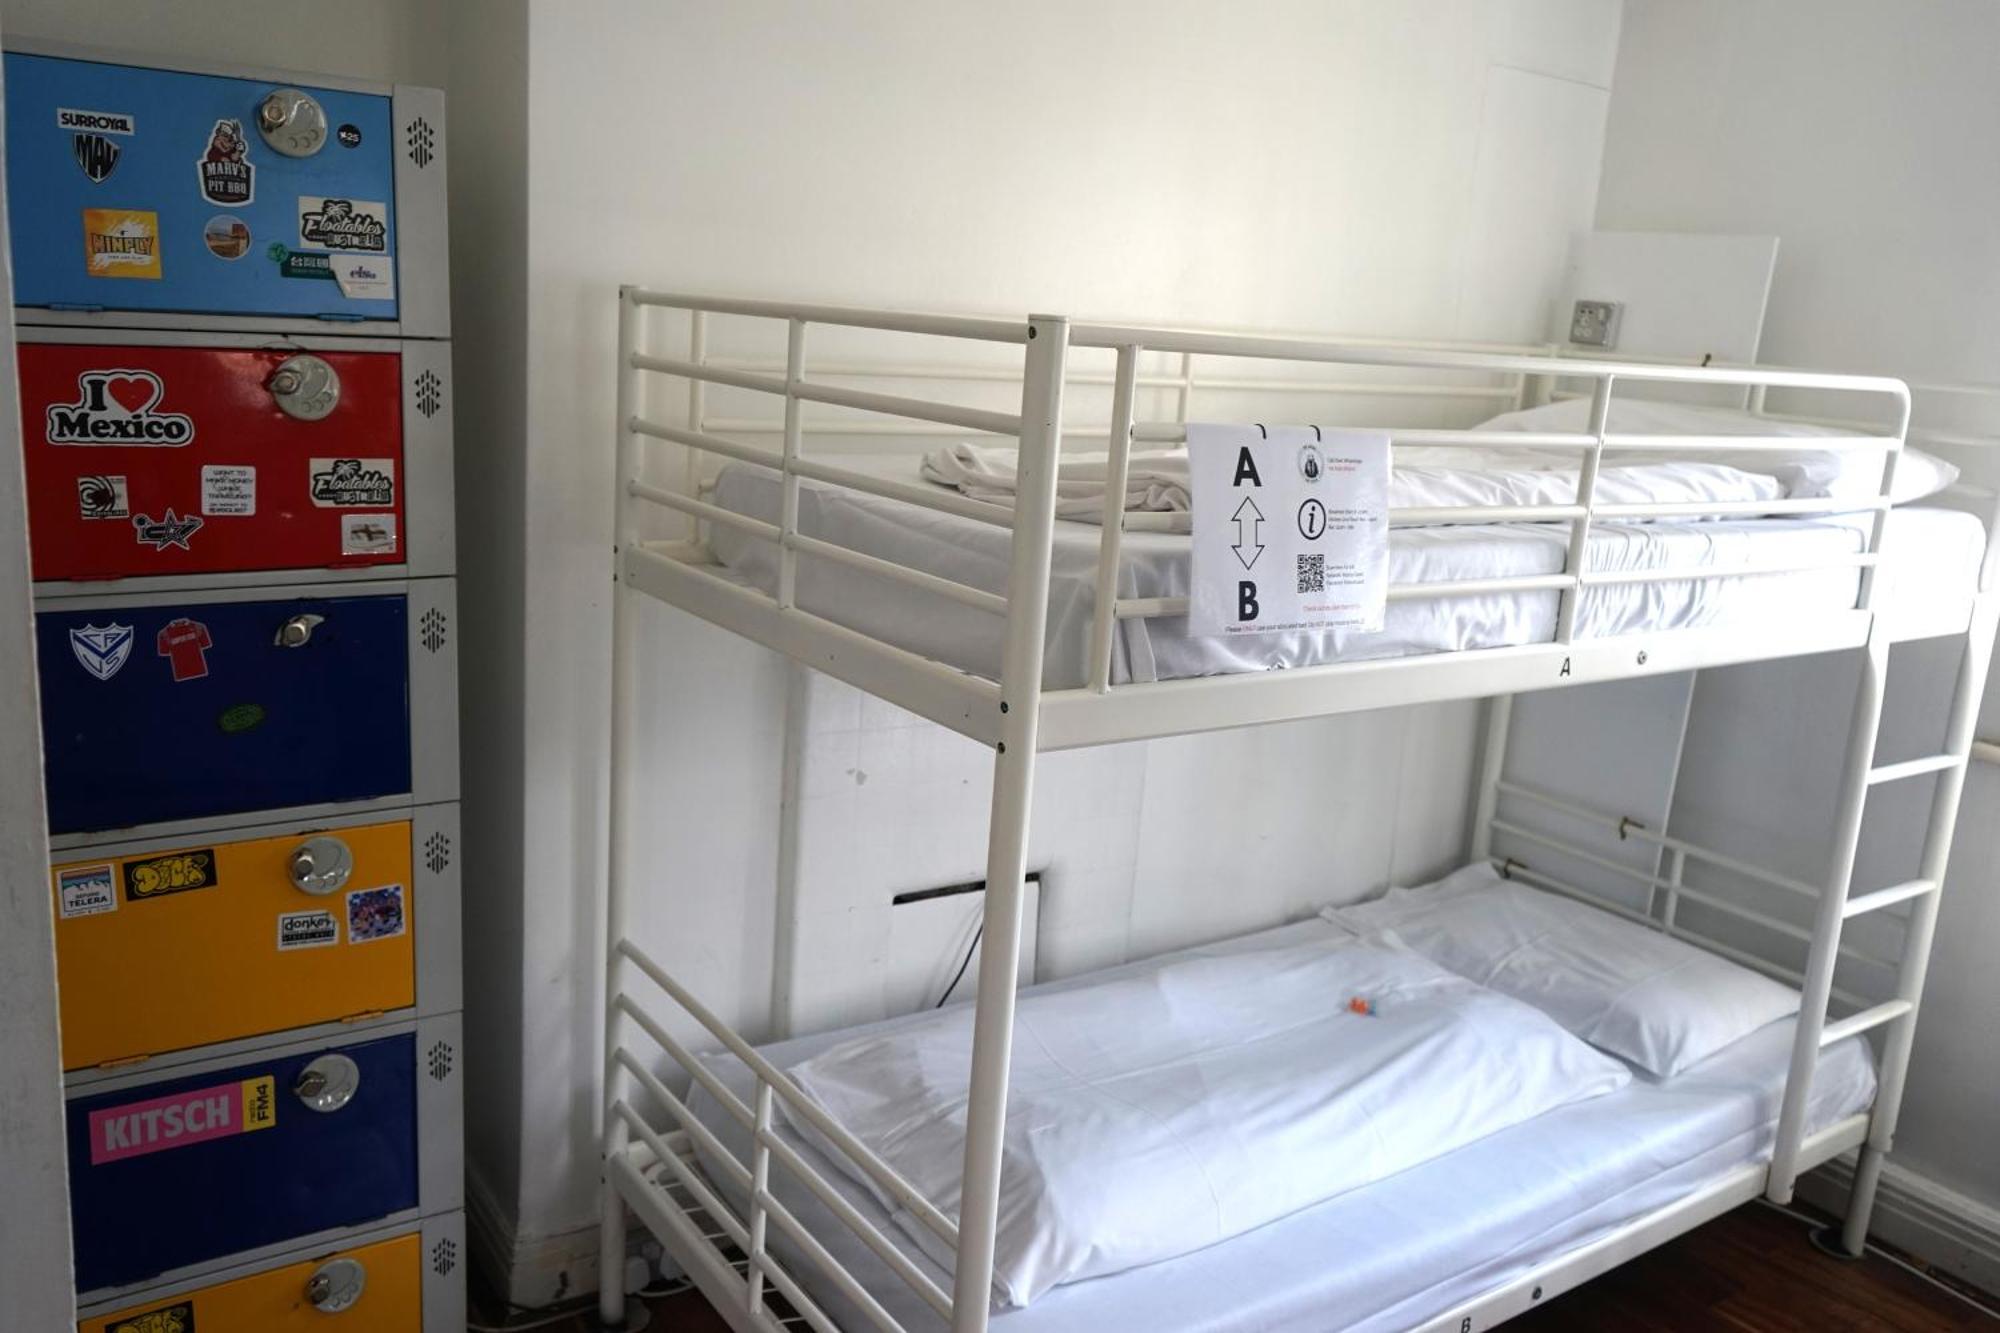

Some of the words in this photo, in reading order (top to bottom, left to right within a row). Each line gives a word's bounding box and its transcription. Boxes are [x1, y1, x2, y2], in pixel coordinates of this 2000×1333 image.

[61, 112, 131, 132] SURROYAL
[206, 160, 247, 179] MARV'S
[208, 180, 225, 193] PIT
[227, 181, 247, 195] BBQ
[304, 213, 384, 237] Floatables
[87, 379, 106, 411] I
[55, 411, 185, 439] Mexico
[1233, 446, 1262, 487] A
[314, 470, 391, 492] Floatables
[1238, 580, 1259, 622] B
[1560, 656, 1571, 677] A
[68, 895, 108, 908] TELERA
[257, 1083, 270, 1121] FM4
[104, 1093, 231, 1152] KITSCH
[1460, 1317, 1471, 1333] B
